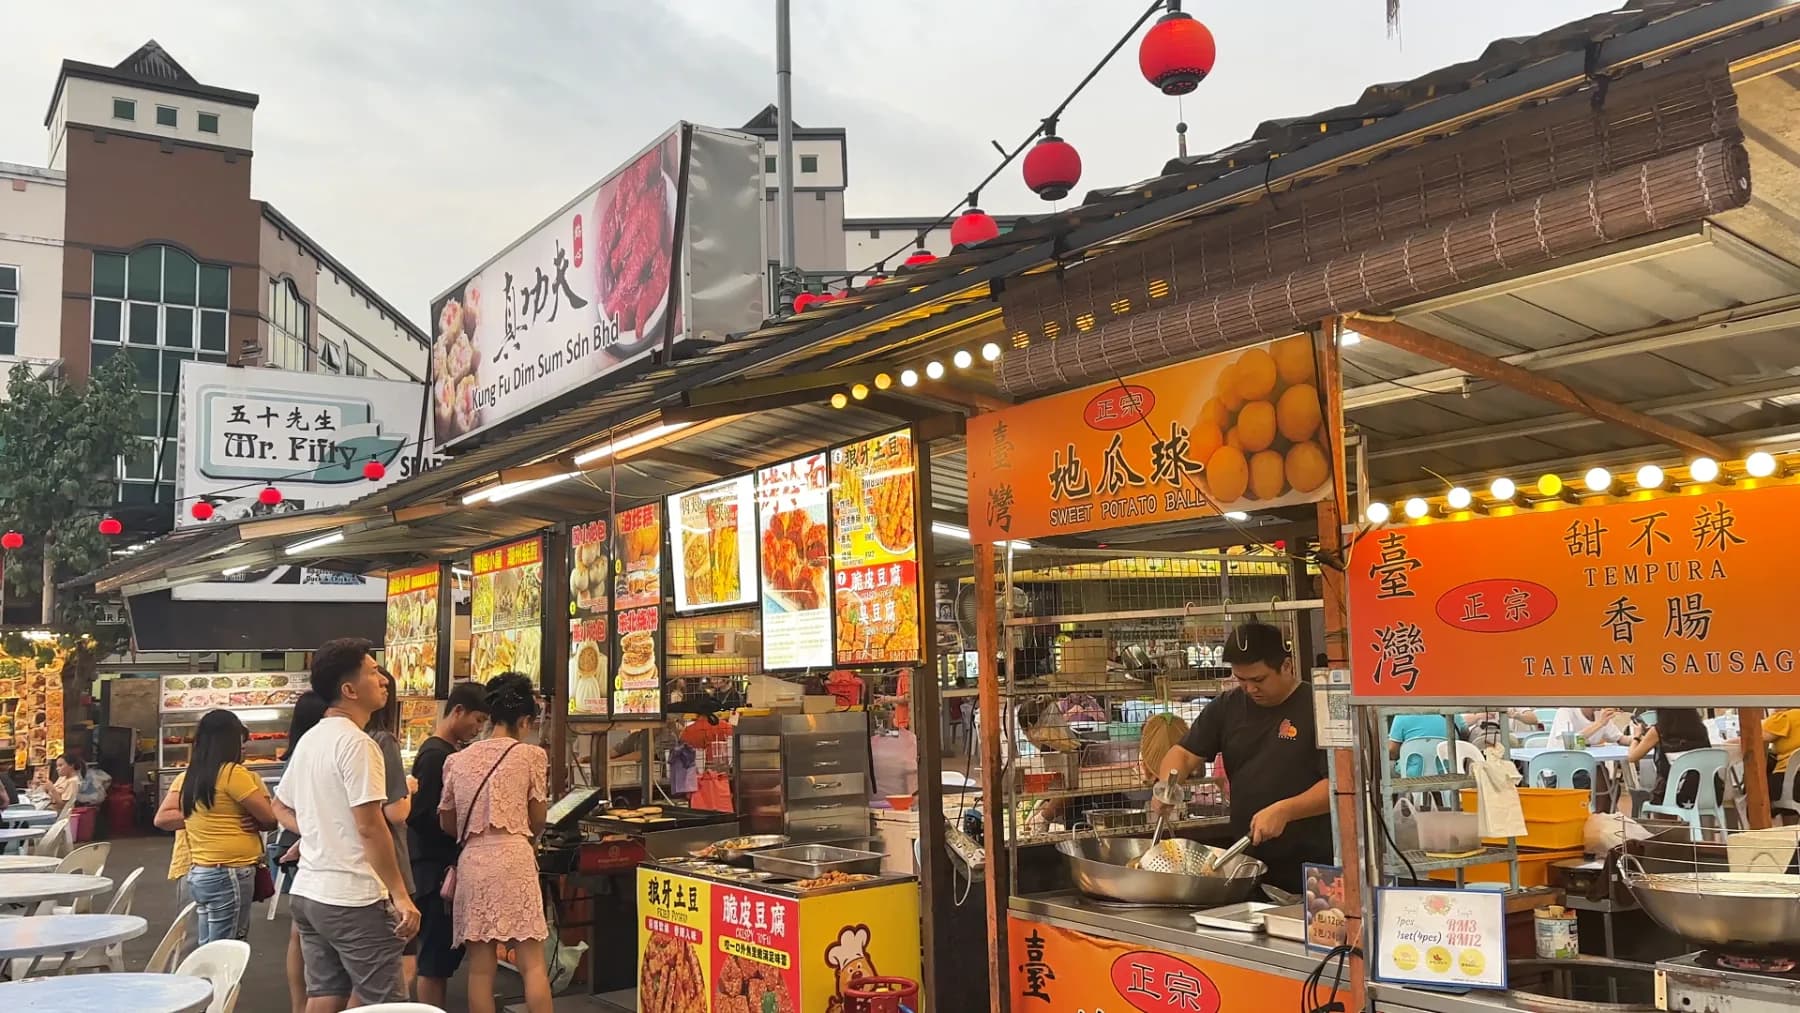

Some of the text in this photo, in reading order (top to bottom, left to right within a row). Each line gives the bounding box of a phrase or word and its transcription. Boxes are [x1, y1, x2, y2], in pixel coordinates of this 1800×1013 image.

[493, 239, 588, 363] 真功夫
[472, 313, 619, 409] Kung Fu Dim Sum Sdn Bhd
[226, 404, 336, 431] 五十先生
[1095, 391, 1143, 422] 正宗
[224, 432, 357, 470] Mr. Fifty
[844, 435, 899, 469] 狼牙土豆
[1048, 423, 1204, 500] 地瓜球
[986, 419, 1014, 533] 臺灣
[1050, 489, 1206, 526] SWEET POTATO BALL
[1563, 501, 1746, 558] 甜不辣
[851, 564, 901, 591] 脆皮豆腐
[1584, 560, 1728, 587] TEMPURA
[859, 600, 896, 626] 臭豆腐
[1369, 531, 1425, 692] 臺灣
[1459, 588, 1531, 622] 正宗
[1601, 594, 1714, 645] 香腸
[1522, 649, 1800, 677] TAIWAN SAUSAG
[648, 876, 699, 912] 狼牙土豆
[722, 893, 785, 938] 脆皮豆腐
[1446, 918, 1477, 932] RM3
[1446, 933, 1482, 947] RM12
[1127, 962, 1201, 1011] 正宗
